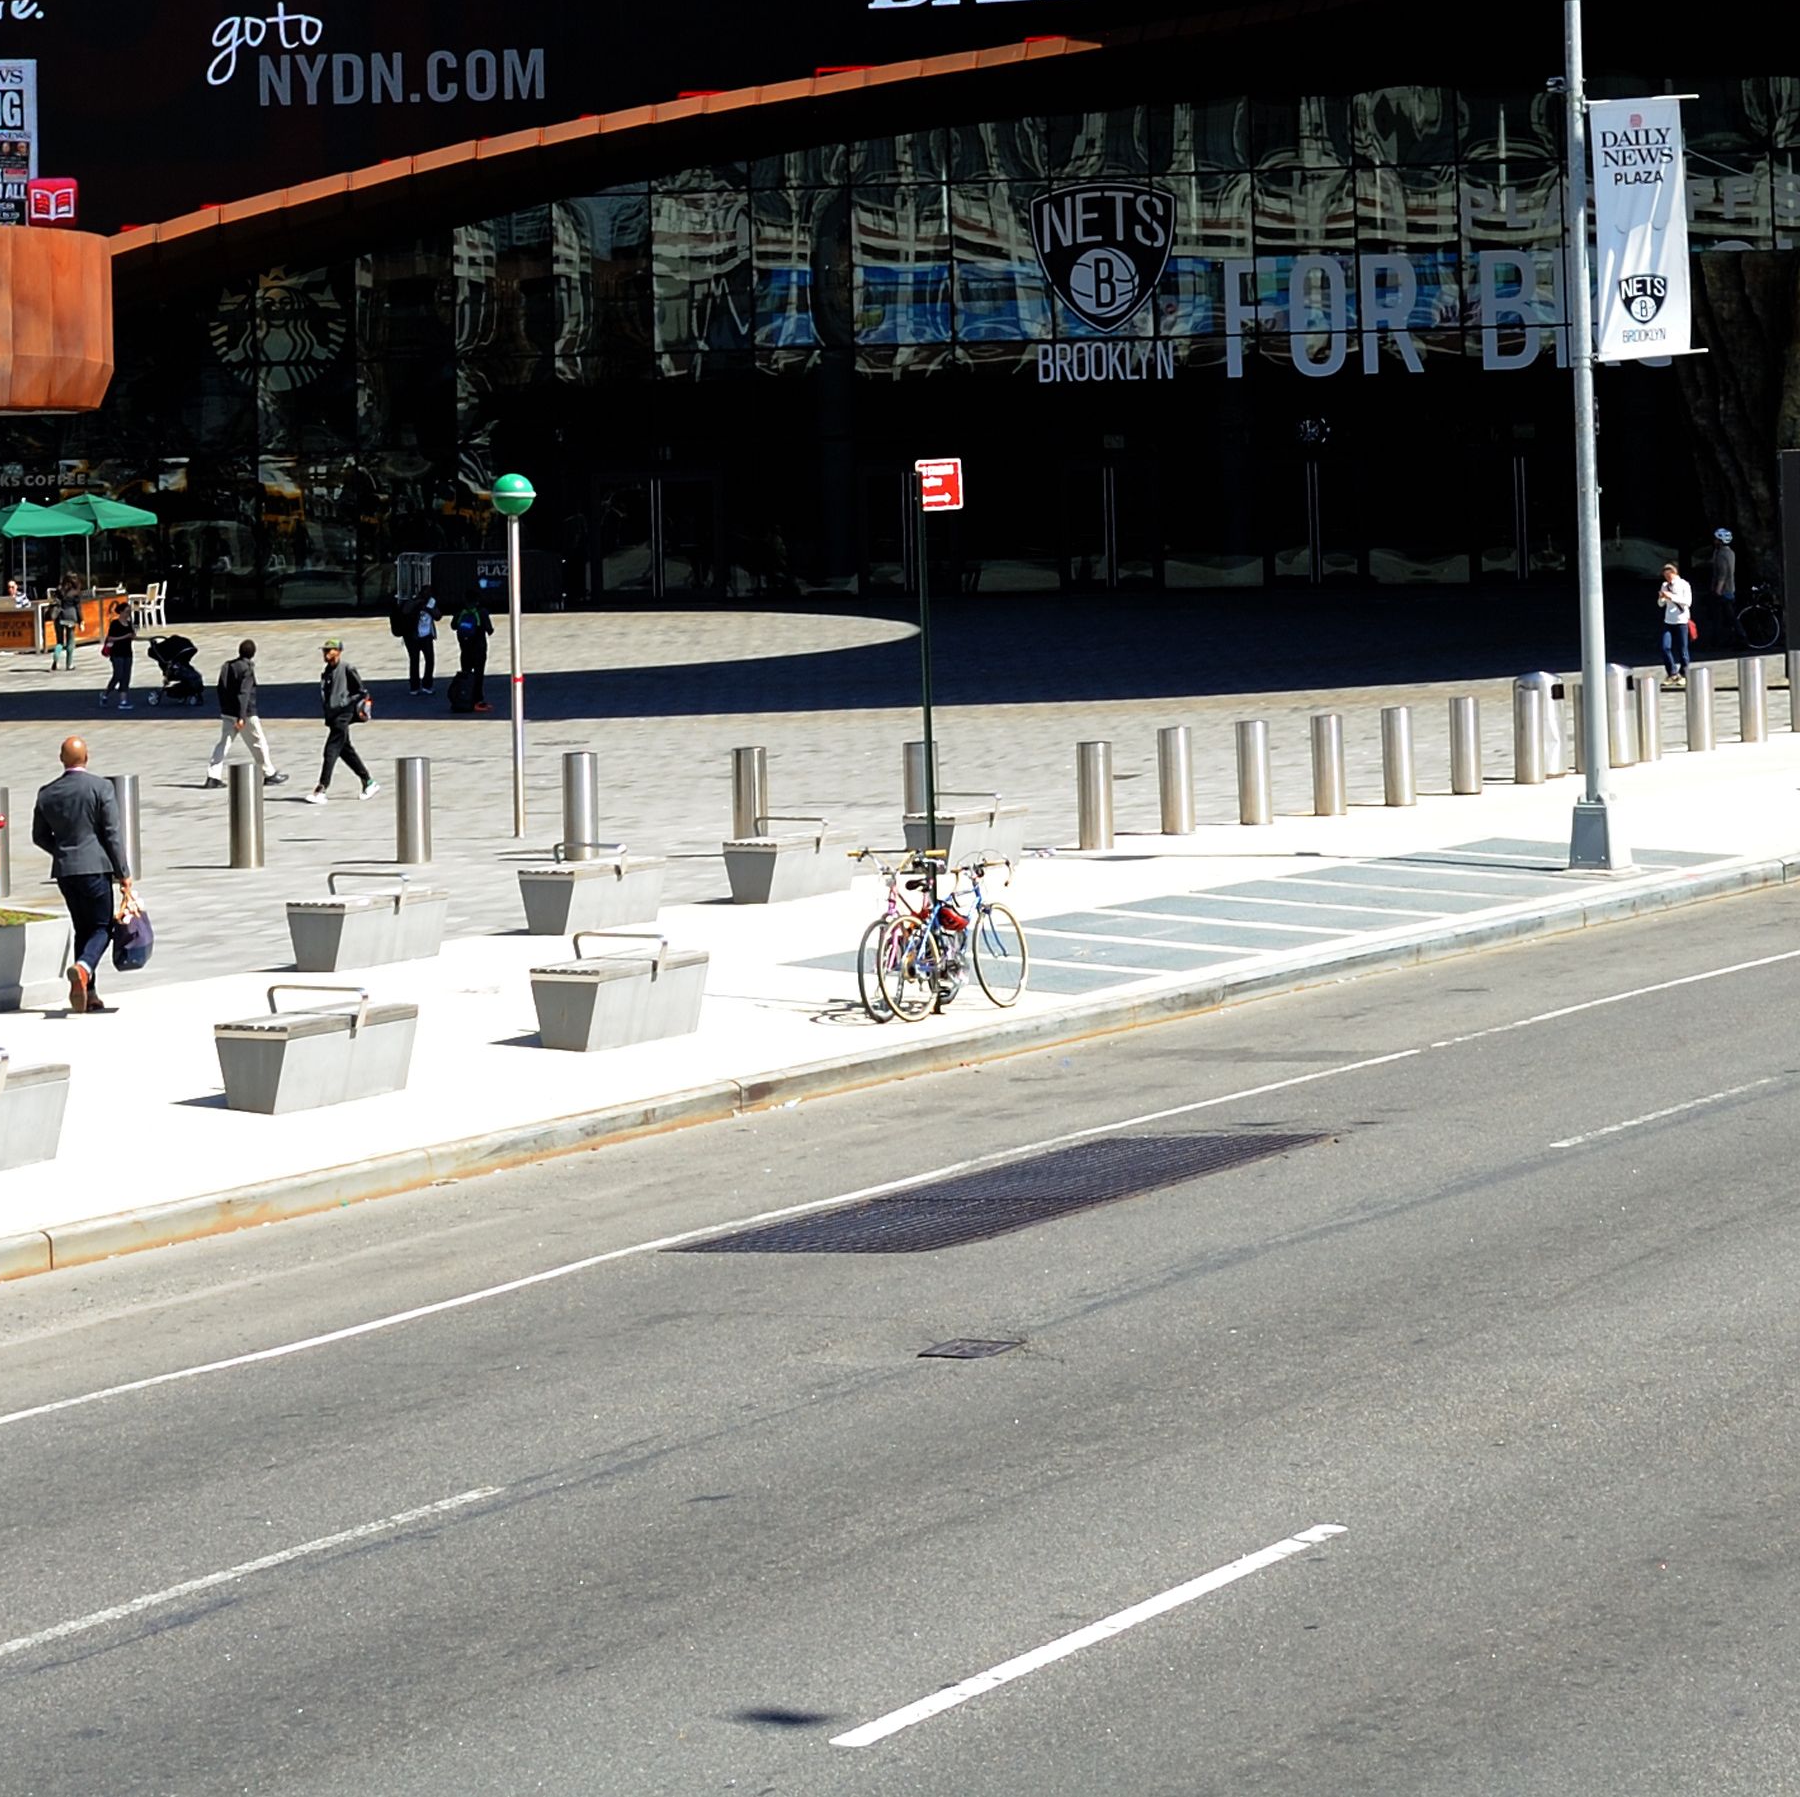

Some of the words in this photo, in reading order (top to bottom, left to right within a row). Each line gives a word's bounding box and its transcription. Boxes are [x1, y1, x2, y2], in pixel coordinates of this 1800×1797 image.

[258, 48, 545, 107] NYDN.COM
[1601, 128, 1672, 149] DAILY
[1602, 147, 1675, 168] NEWS
[1614, 170, 1664, 186] PLAZA
[5, 183, 27, 199] ALL
[1042, 190, 1167, 254] NETS
[1093, 257, 1116, 308] B
[1620, 276, 1666, 300] NETS
[1224, 254, 1426, 379] FOR
[1622, 328, 1666, 343] BROOKLYN
[1037, 340, 1175, 384] BROOKLYN
[477, 564, 509, 577] PLAZ
